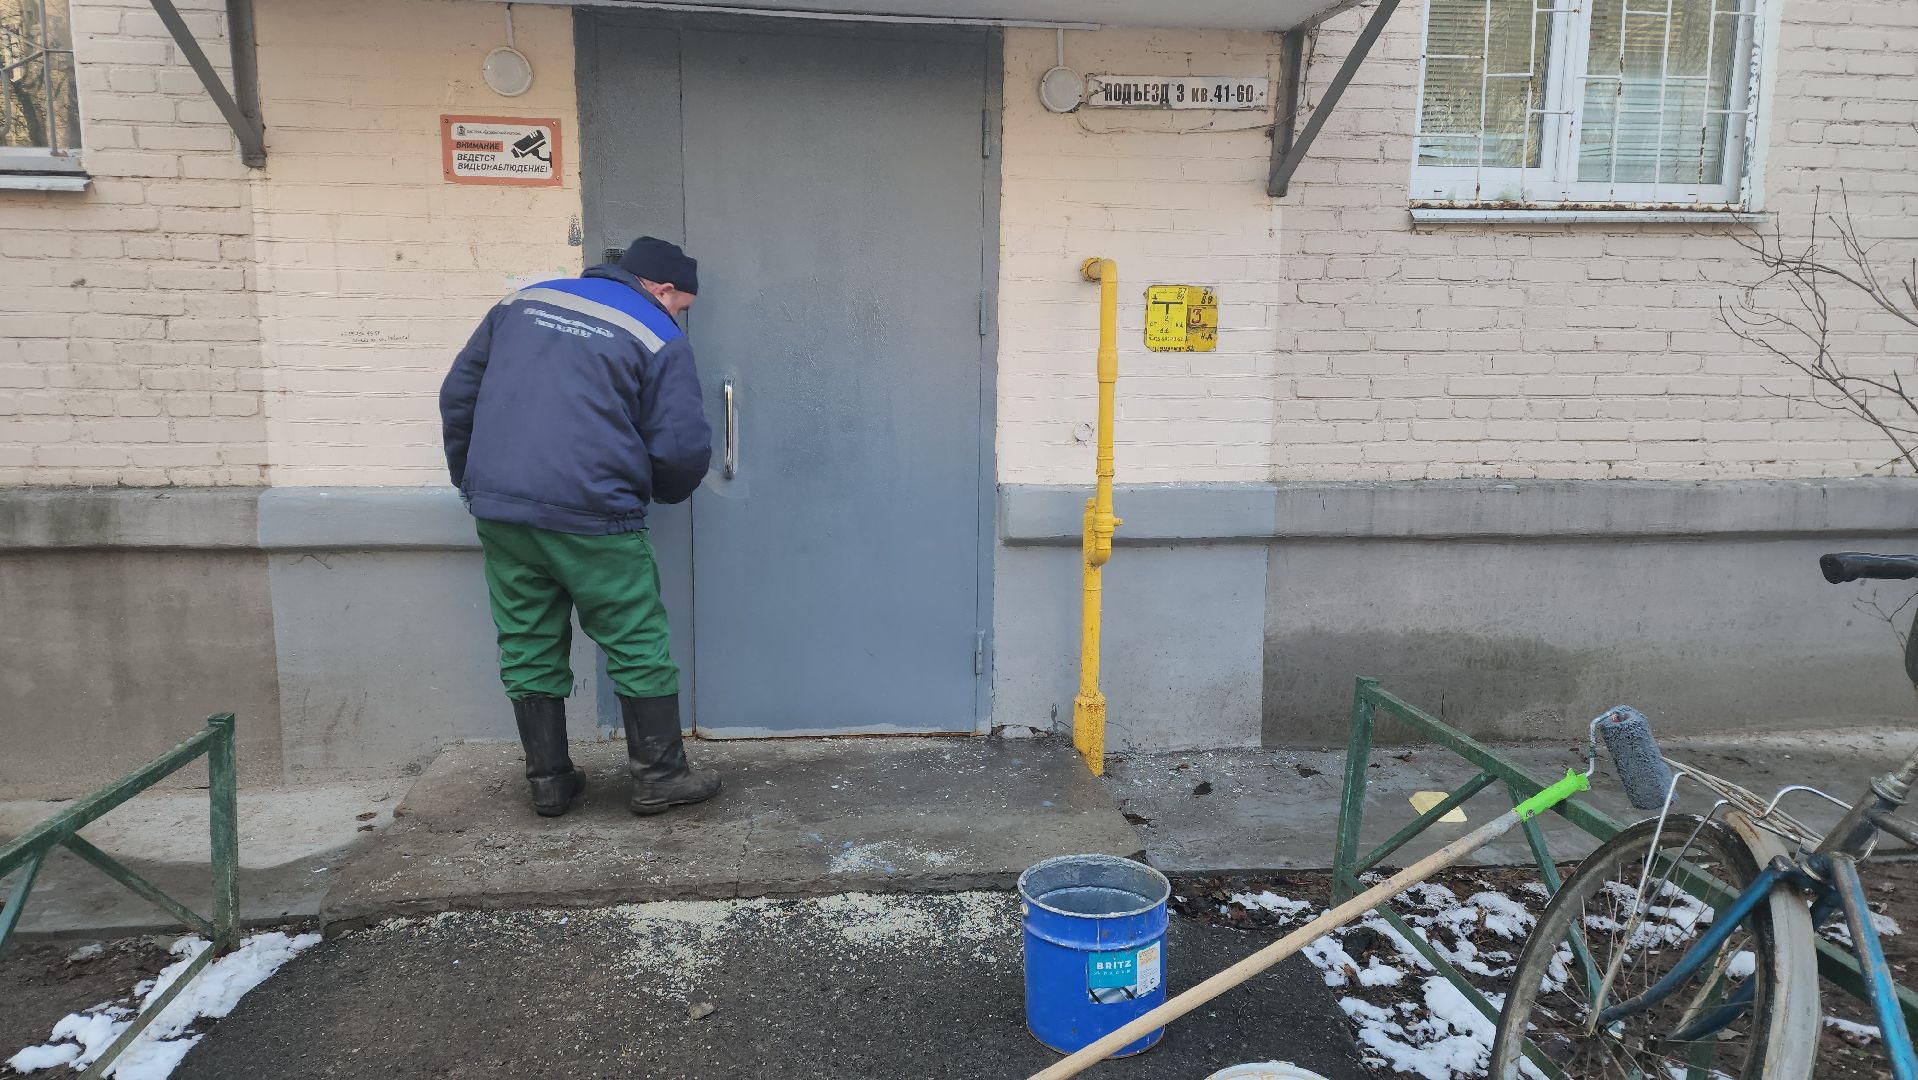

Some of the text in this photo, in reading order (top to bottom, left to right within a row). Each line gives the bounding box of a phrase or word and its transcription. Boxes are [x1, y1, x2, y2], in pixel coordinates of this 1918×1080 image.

[1176, 84, 1185, 102] 3
[456, 141, 500, 150] ВНИМАНИЕ
[457, 153, 496, 162] ВЕДЕТСЯ
[457, 162, 548, 173] ВИДЕОНАБЛЮДЕНИЕ!
[1096, 960, 1132, 970] BRITZ
